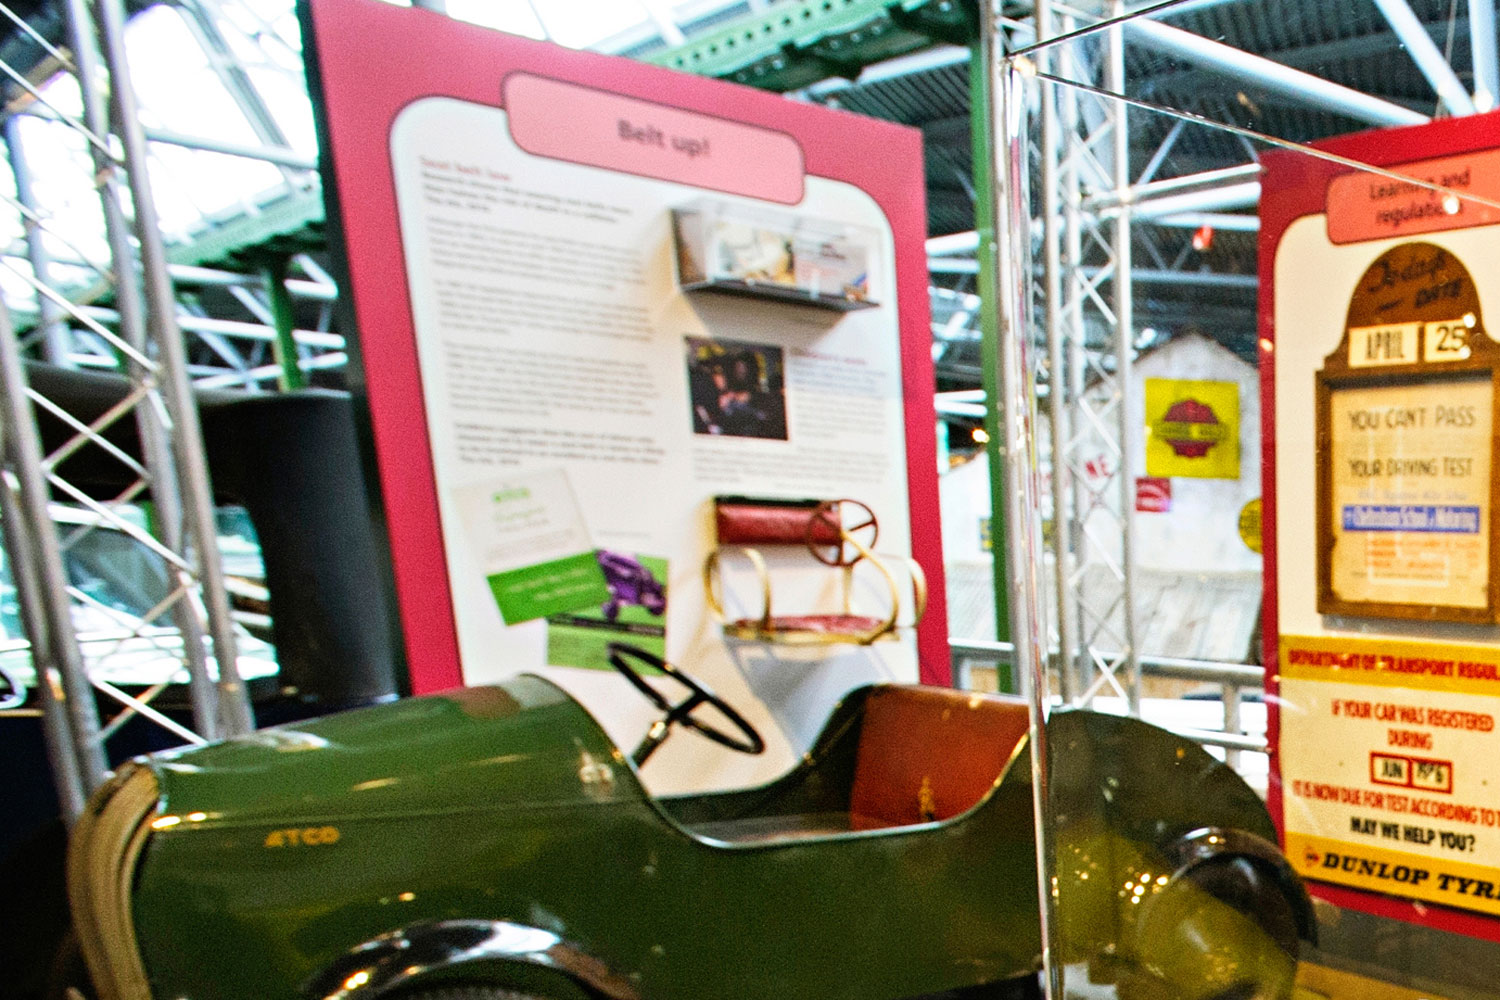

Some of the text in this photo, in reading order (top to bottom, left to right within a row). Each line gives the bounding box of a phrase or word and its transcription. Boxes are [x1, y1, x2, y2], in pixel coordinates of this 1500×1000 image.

[618, 118, 710, 159] Belt up!
[1441, 166, 1470, 188] and
[1436, 325, 1466, 352] 25
[1349, 410, 1380, 430] YOU
[1435, 404, 1476, 427] PASS
[1349, 457, 1473, 477] YOUR DRIVING TEST
[1289, 649, 1360, 670] DEPARTMENT
[1363, 654, 1376, 670] OF
[1380, 655, 1453, 676] TRANSPORT
[1332, 700, 1495, 733] IF YOUR CAR WAS REGISTERED
[1388, 729, 1432, 750] DURING
[1382, 759, 1403, 778] JUN
[1314, 783, 1339, 801] NOW
[1341, 786, 1361, 805] DUE
[1364, 789, 1384, 809] FOR
[1387, 792, 1409, 813] TEST
[1410, 797, 1477, 824] ACCORDING
[1480, 808, 1495, 827] TO
[1350, 816, 1475, 852] MAY WE HELP YOU?
[1322, 852, 1430, 885] DUNLOP
